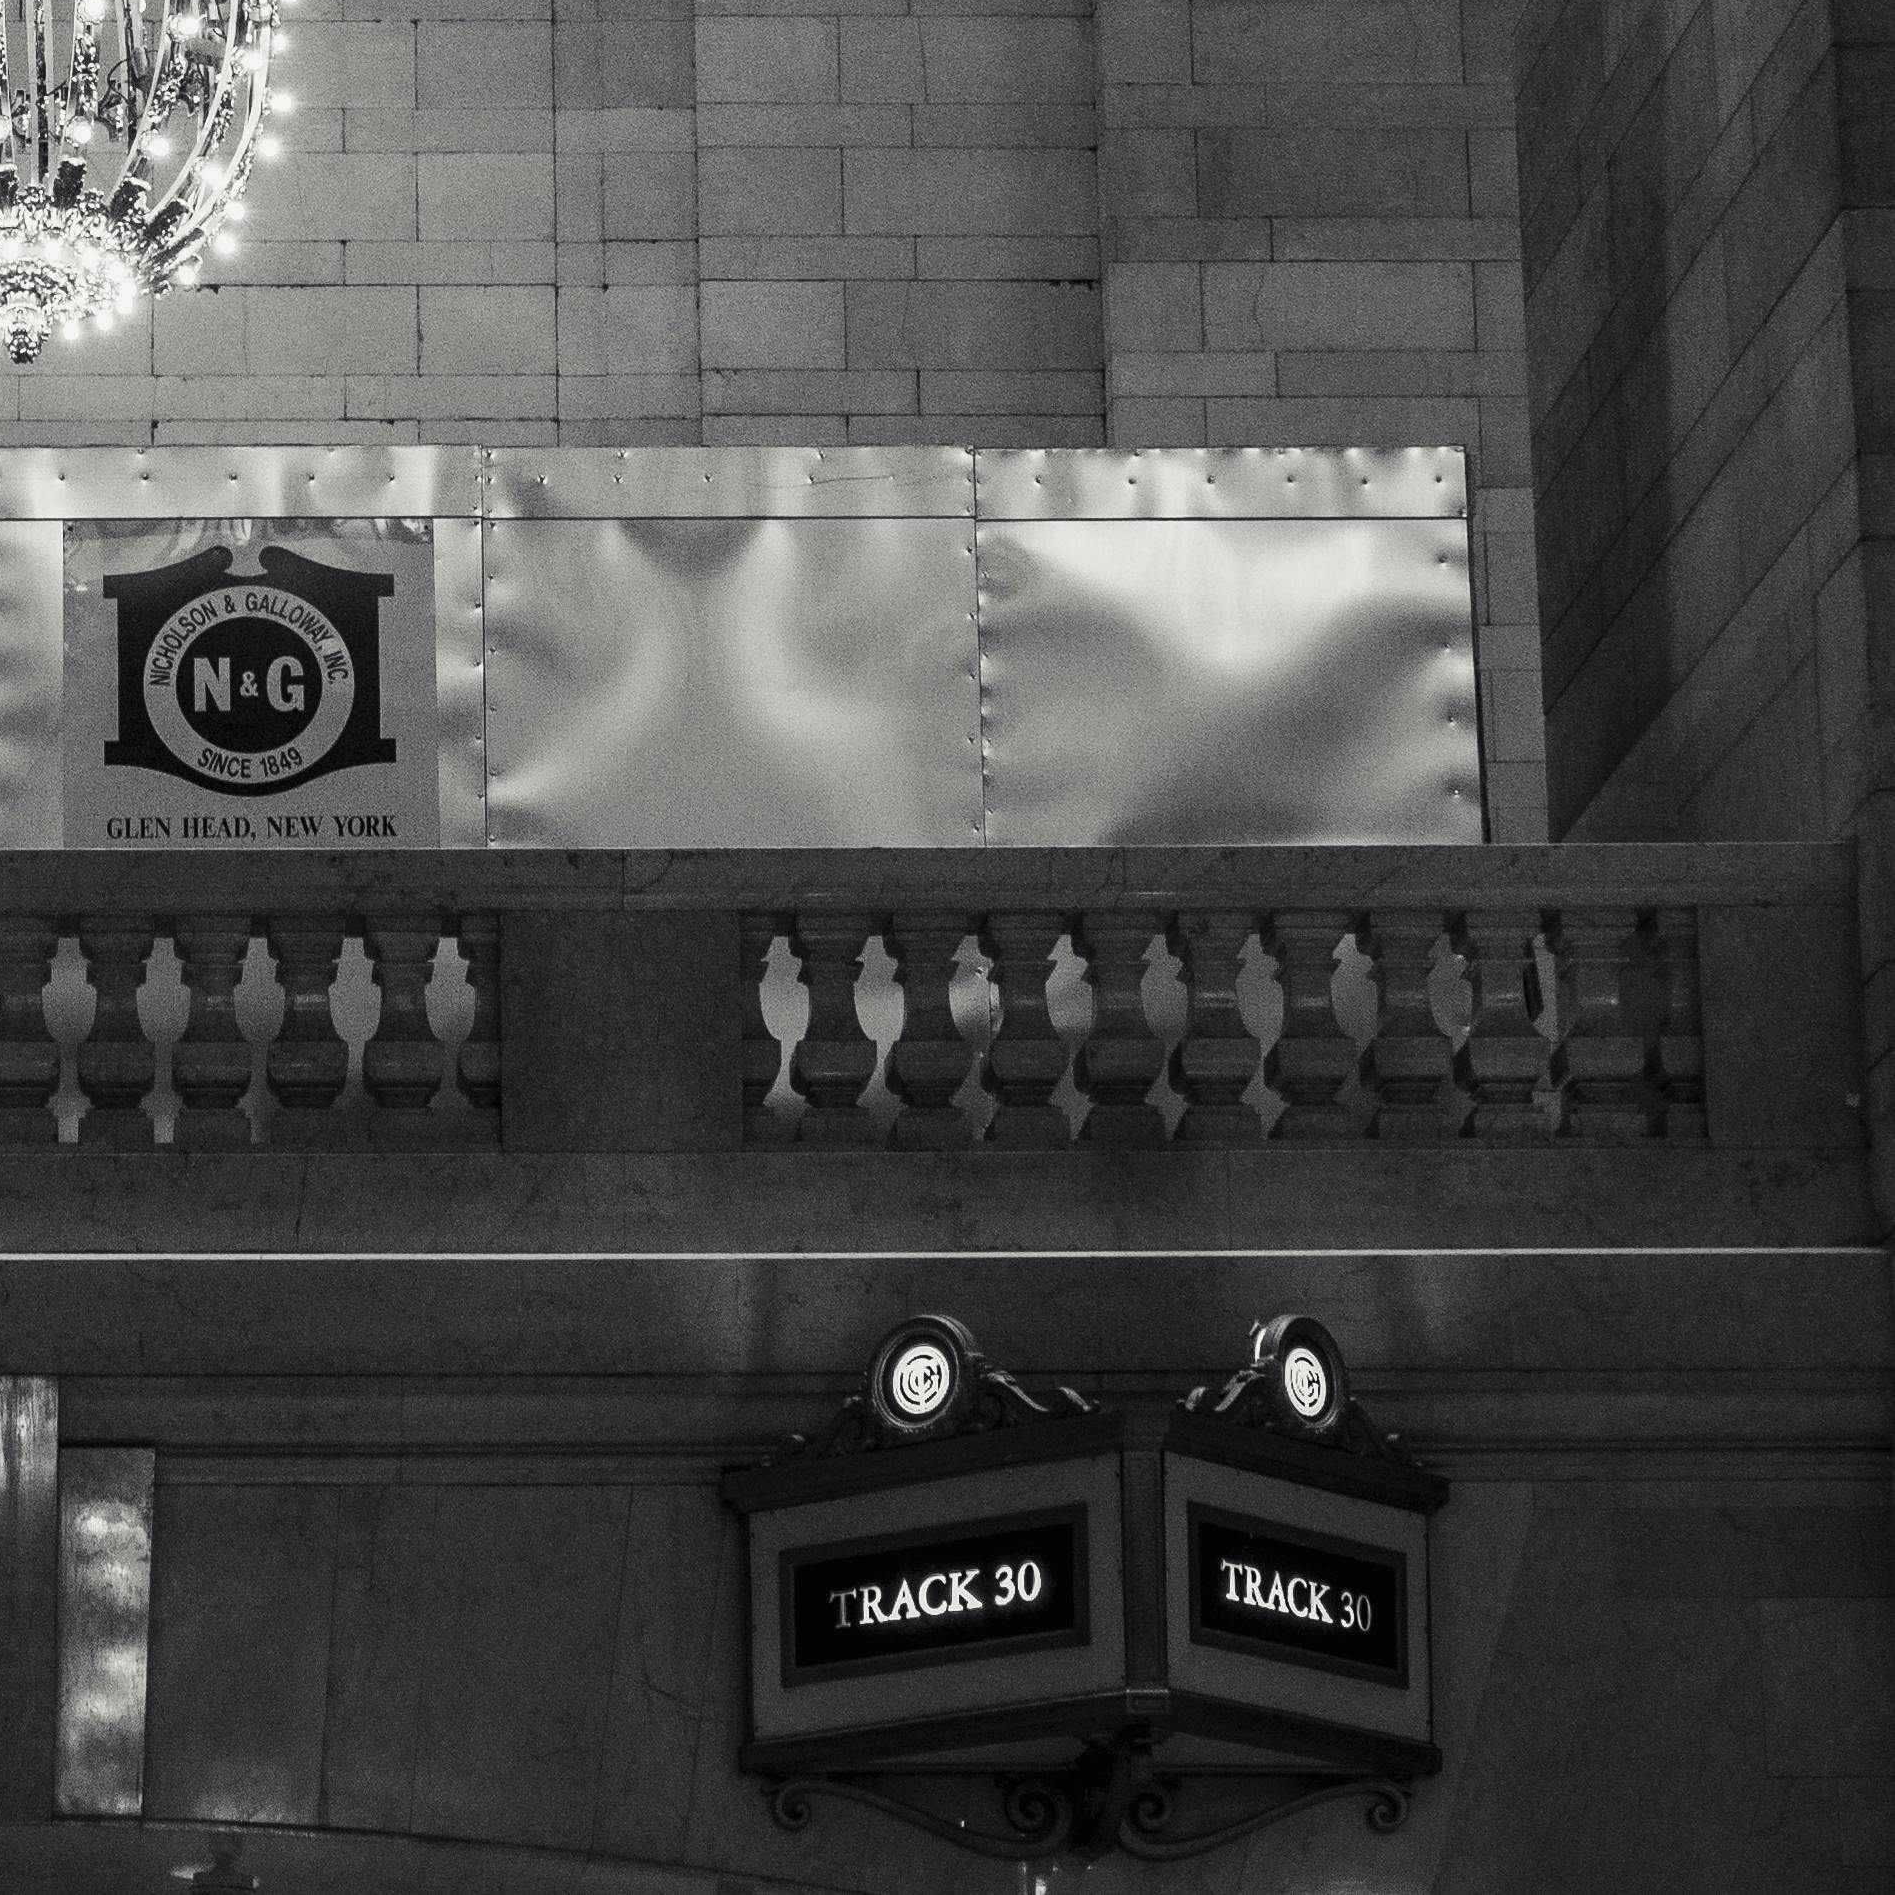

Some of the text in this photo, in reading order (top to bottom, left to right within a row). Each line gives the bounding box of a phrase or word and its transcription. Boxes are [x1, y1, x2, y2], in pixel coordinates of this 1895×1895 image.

[150, 601, 219, 687] NICHOLSON
[224, 595, 237, 612] &
[197, 747, 303, 778] SINCE 1849
[106, 814, 397, 841] GLEN HEAD, NEW YORK
[829, 1560, 1042, 1630] TRACK 30
[1220, 1558, 1372, 1632] TRACK 30
